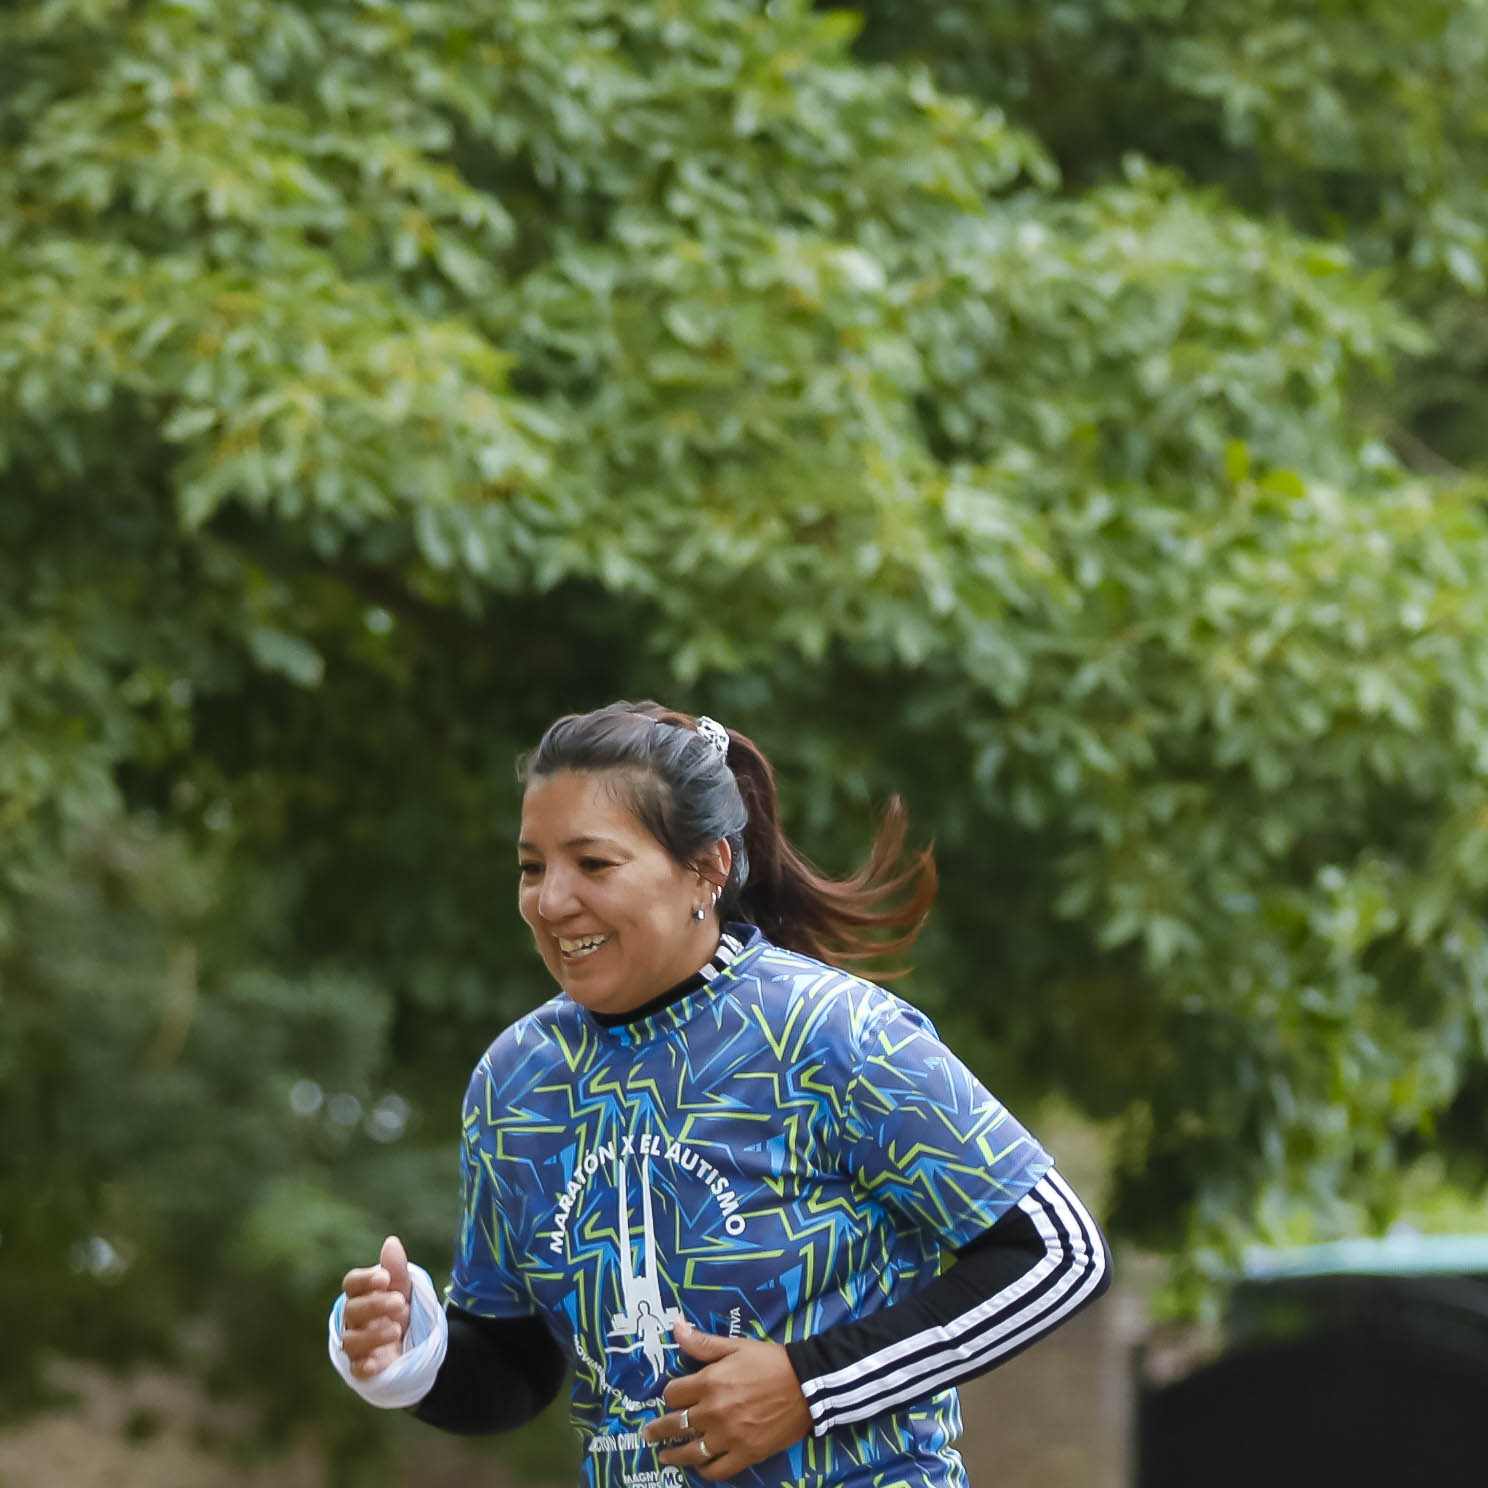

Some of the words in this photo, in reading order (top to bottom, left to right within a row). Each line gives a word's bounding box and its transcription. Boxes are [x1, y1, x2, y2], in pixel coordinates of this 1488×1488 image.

[549, 1141, 615, 1254] MARATÓN
[621, 1133, 635, 1156] X
[640, 1133, 661, 1156] EL
[664, 1141, 746, 1236] AUTISMO
[623, 1471, 660, 1484] MAGNY
